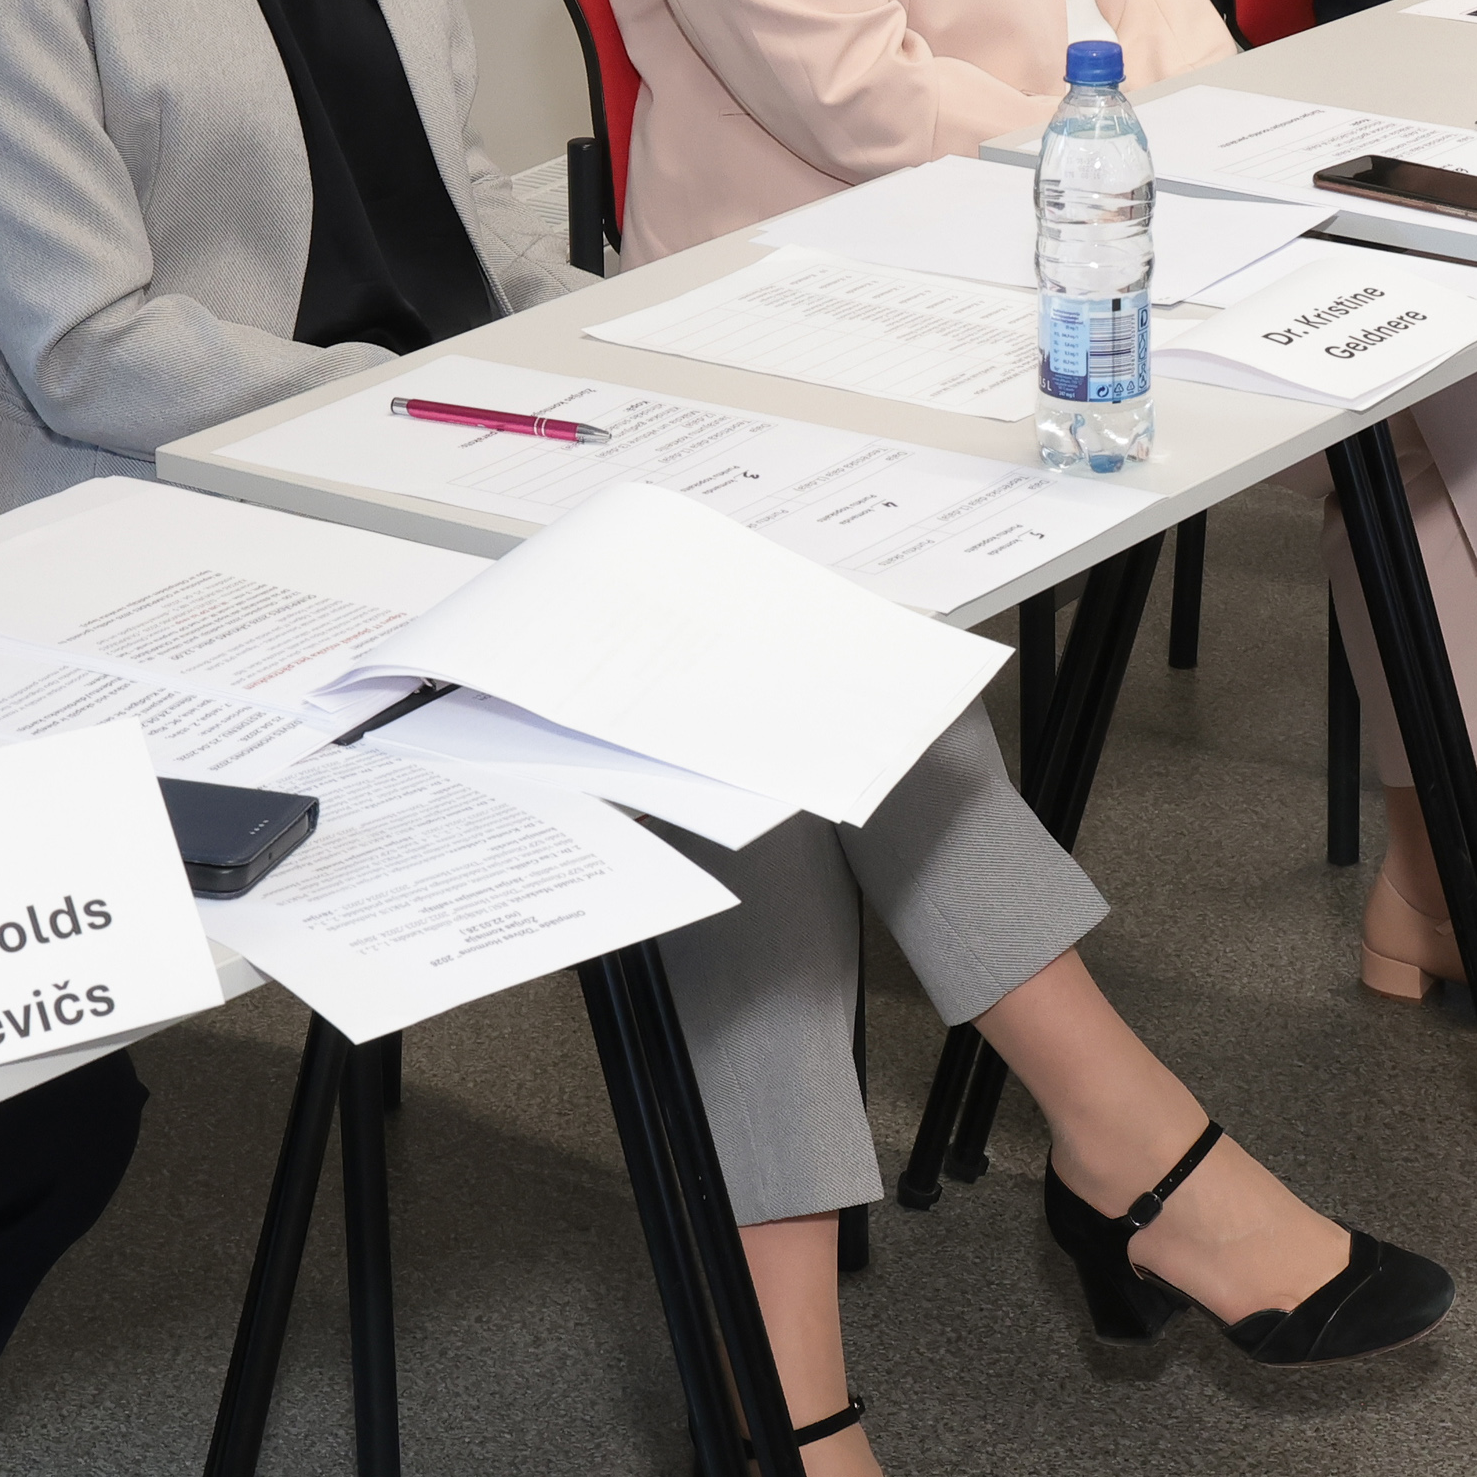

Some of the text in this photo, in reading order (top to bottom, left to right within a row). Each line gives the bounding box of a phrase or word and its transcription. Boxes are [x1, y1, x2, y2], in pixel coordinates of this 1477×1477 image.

[1262, 323, 1307, 346] Dr.
[1324, 310, 1428, 362] Geldnere
[464, 914, 537, 942] Žūrijas komisija
[539, 907, 586, 929] Olimpiāde
